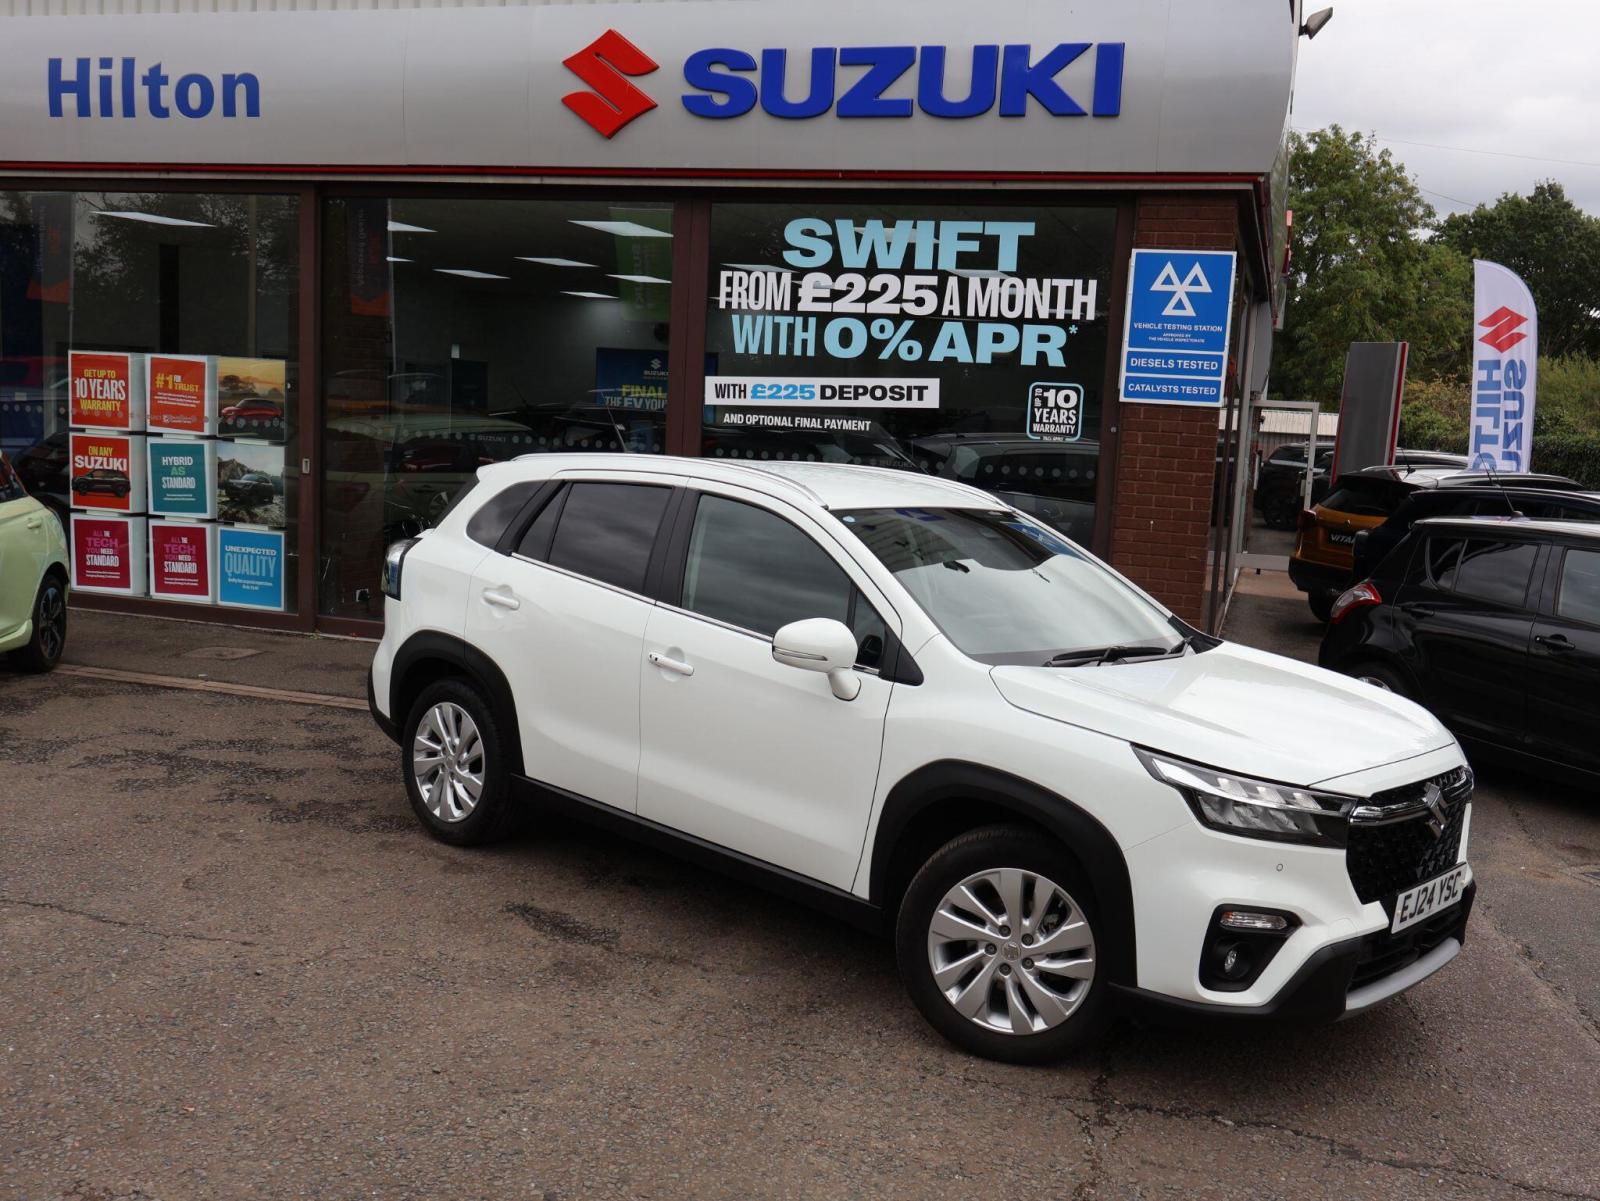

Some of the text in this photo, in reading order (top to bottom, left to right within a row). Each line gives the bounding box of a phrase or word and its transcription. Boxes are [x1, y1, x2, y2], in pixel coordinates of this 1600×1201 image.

[48, 56, 260, 118] Hilton
[681, 42, 1125, 119] SUZUKI
[782, 217, 1036, 272] SWIFT
[719, 270, 1098, 320] FROM £225 A MONTH
[1133, 322, 1223, 333] VEHICLE TESTING STATION
[731, 314, 817, 357] WITH
[823, 317, 923, 362] 0%
[1130, 357, 1218, 370] DIESELS TESTED
[84, 369, 116, 379] GET UP TO
[155, 373, 174, 390] #1
[174, 382, 199, 392] TRUST
[74, 377, 126, 400] 10 YEARS
[715, 383, 929, 401] WITH £225 DEPOSIT
[1128, 383, 1217, 396] CATALYSTS TESTED
[623, 397, 643, 409] EV
[1034, 388, 1043, 407] UP TO
[1043, 388, 1078, 409] 10
[80, 399, 121, 412] WARRANTY
[723, 413, 872, 431] AND OPTIONAL FINAL PAYMENT
[1034, 407, 1077, 425] YEARS
[1032, 423, 1076, 434] WARRANTY
[88, 445, 113, 457] ON ANY
[74, 455, 128, 471] SUZUKI
[162, 456, 193, 466] HYBRID
[171, 466, 186, 476] AS
[161, 476, 196, 489] STANDARD
[85, 537, 119, 548] TECH
[163, 543, 197, 554] TECH
[224, 545, 277, 556] UNEXPECTED
[85, 554, 120, 567] STANDARD
[224, 552, 277, 578] QUALITY
[163, 561, 198, 574] STANDARD
[1399, 870, 1462, 923] EJ24 YSC
